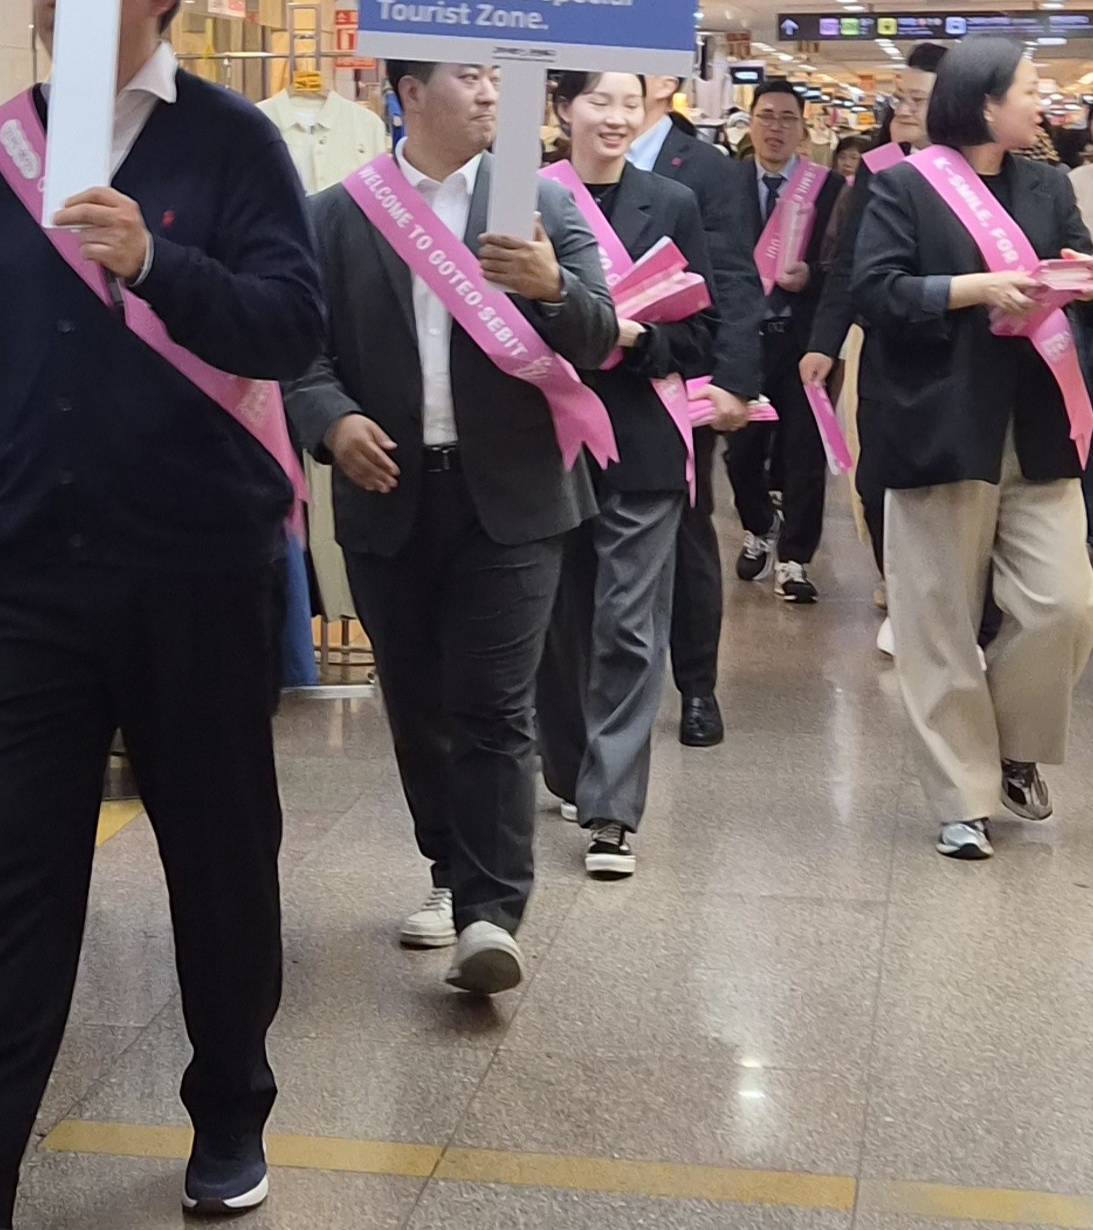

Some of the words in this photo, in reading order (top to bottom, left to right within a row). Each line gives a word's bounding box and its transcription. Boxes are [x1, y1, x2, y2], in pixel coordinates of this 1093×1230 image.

[475, 3, 549, 30] Zone.
[358, 166, 414, 229] WELCOME
[407, 224, 433, 250] TO
